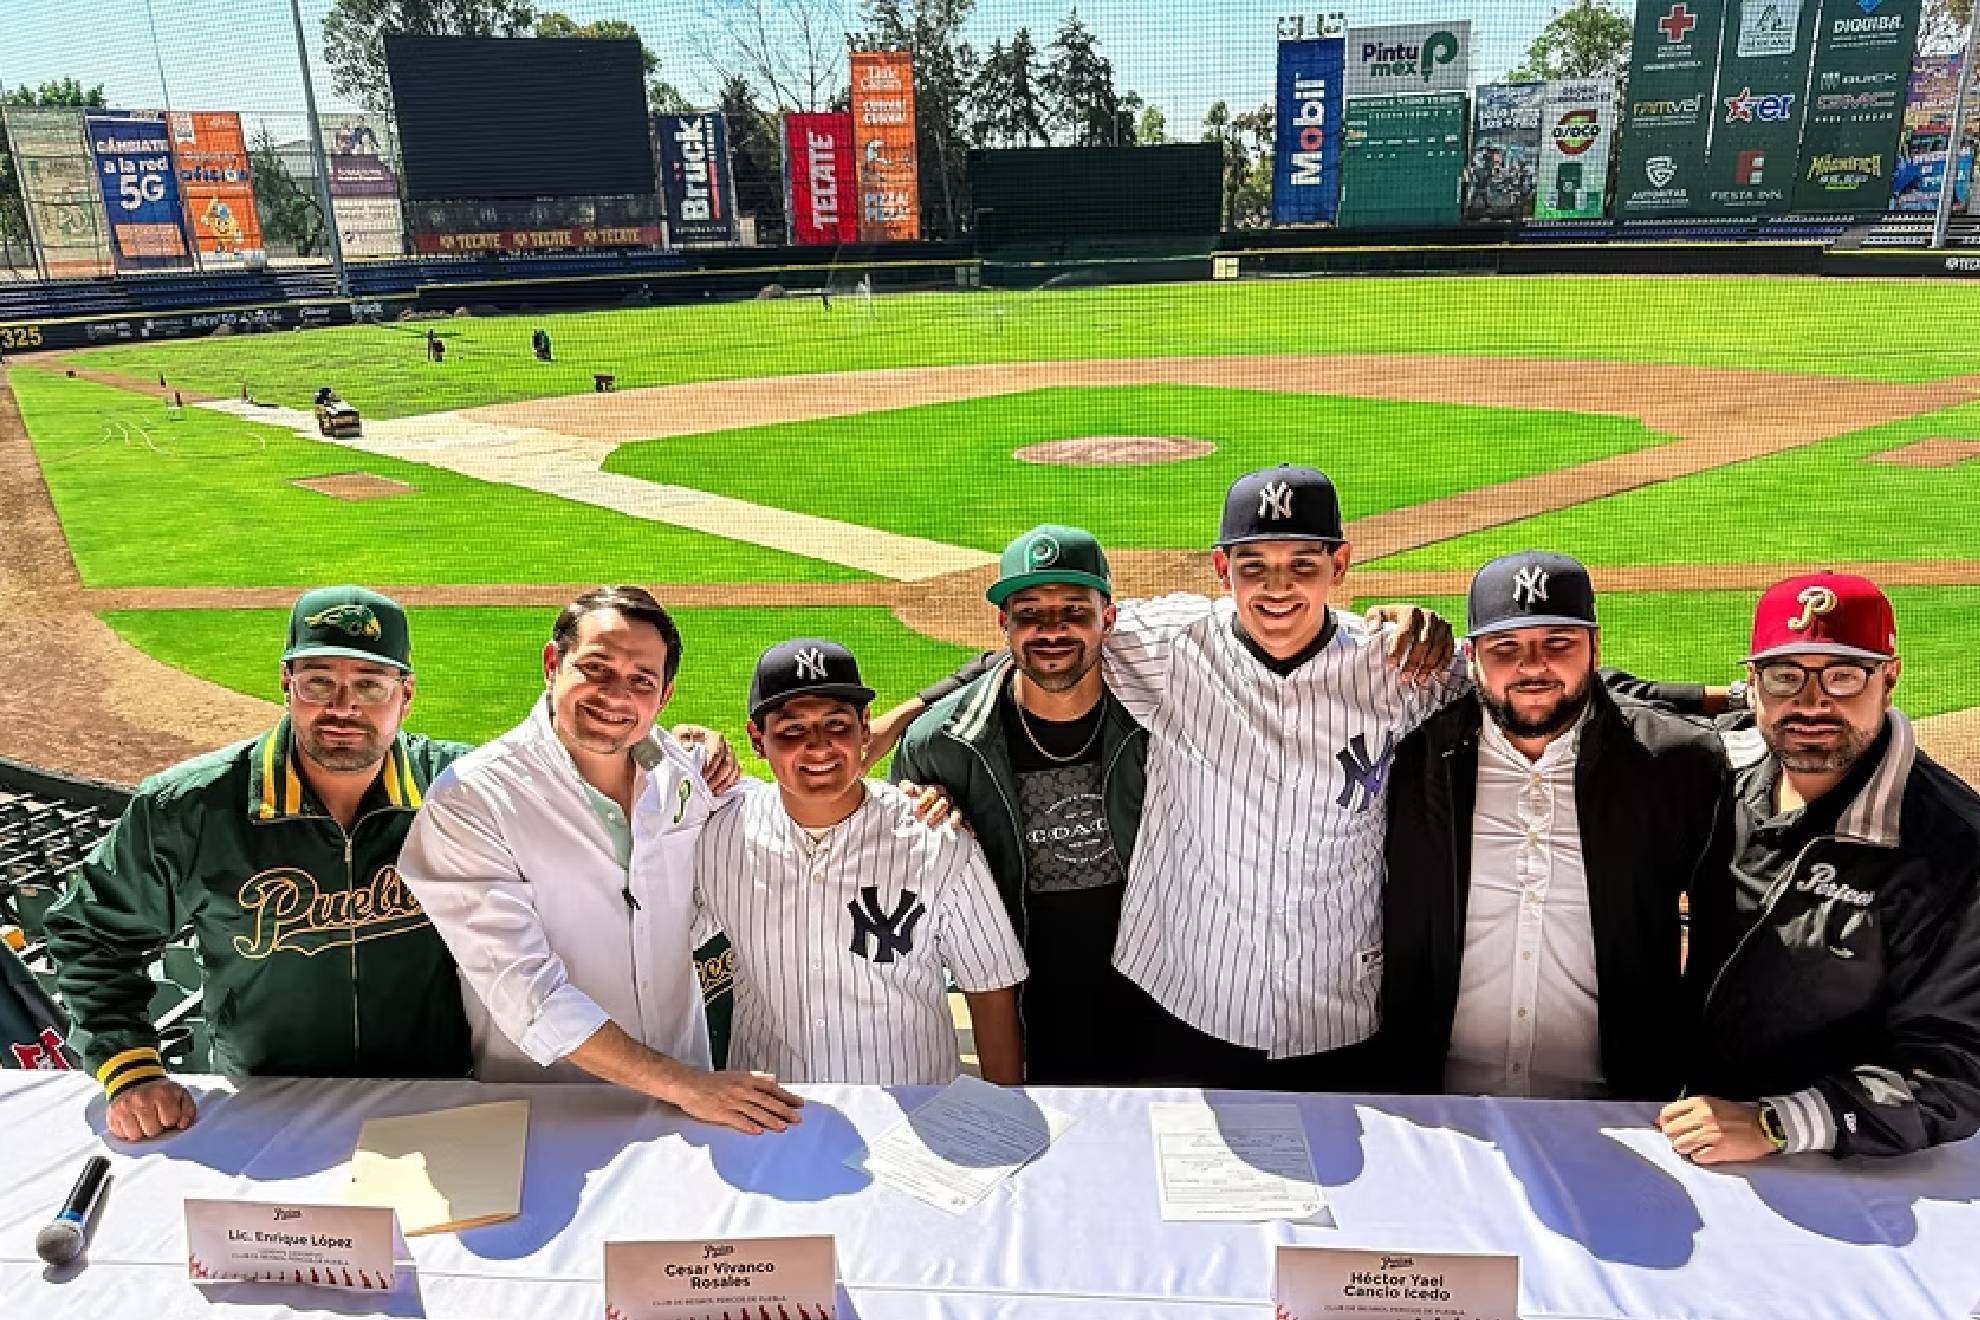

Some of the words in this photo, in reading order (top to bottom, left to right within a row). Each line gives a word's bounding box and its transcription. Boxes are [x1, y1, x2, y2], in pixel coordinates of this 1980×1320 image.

[1362, 43, 1419, 62] Pintu
[1370, 61, 1417, 77] mex
[1290, 78, 1325, 185] Mobil
[104, 160, 117, 174] a
[118, 157, 136, 174] la
[139, 156, 169, 171] red
[808, 128, 840, 232] TECATE
[120, 174, 164, 210] 5G
[0, 326, 44, 349] 325
[1258, 480, 1294, 521] NY
[1512, 565, 1550, 604] NY
[1787, 585, 1838, 631] P
[794, 647, 829, 680] NY
[847, 886, 927, 964] NY
[228, 1229, 252, 1242] Lic.
[254, 1231, 308, 1247] Enrique
[311, 1233, 353, 1249] López
[665, 1263, 709, 1277] Cesar
[713, 1262, 775, 1275] Vivanco
[1352, 1271, 1407, 1285] Héctor
[1409, 1273, 1444, 1287] Yael
[690, 1275, 751, 1289] Rosales
[1343, 1285, 1401, 1299] Cancio
[1404, 1287, 1451, 1301] Icedo
